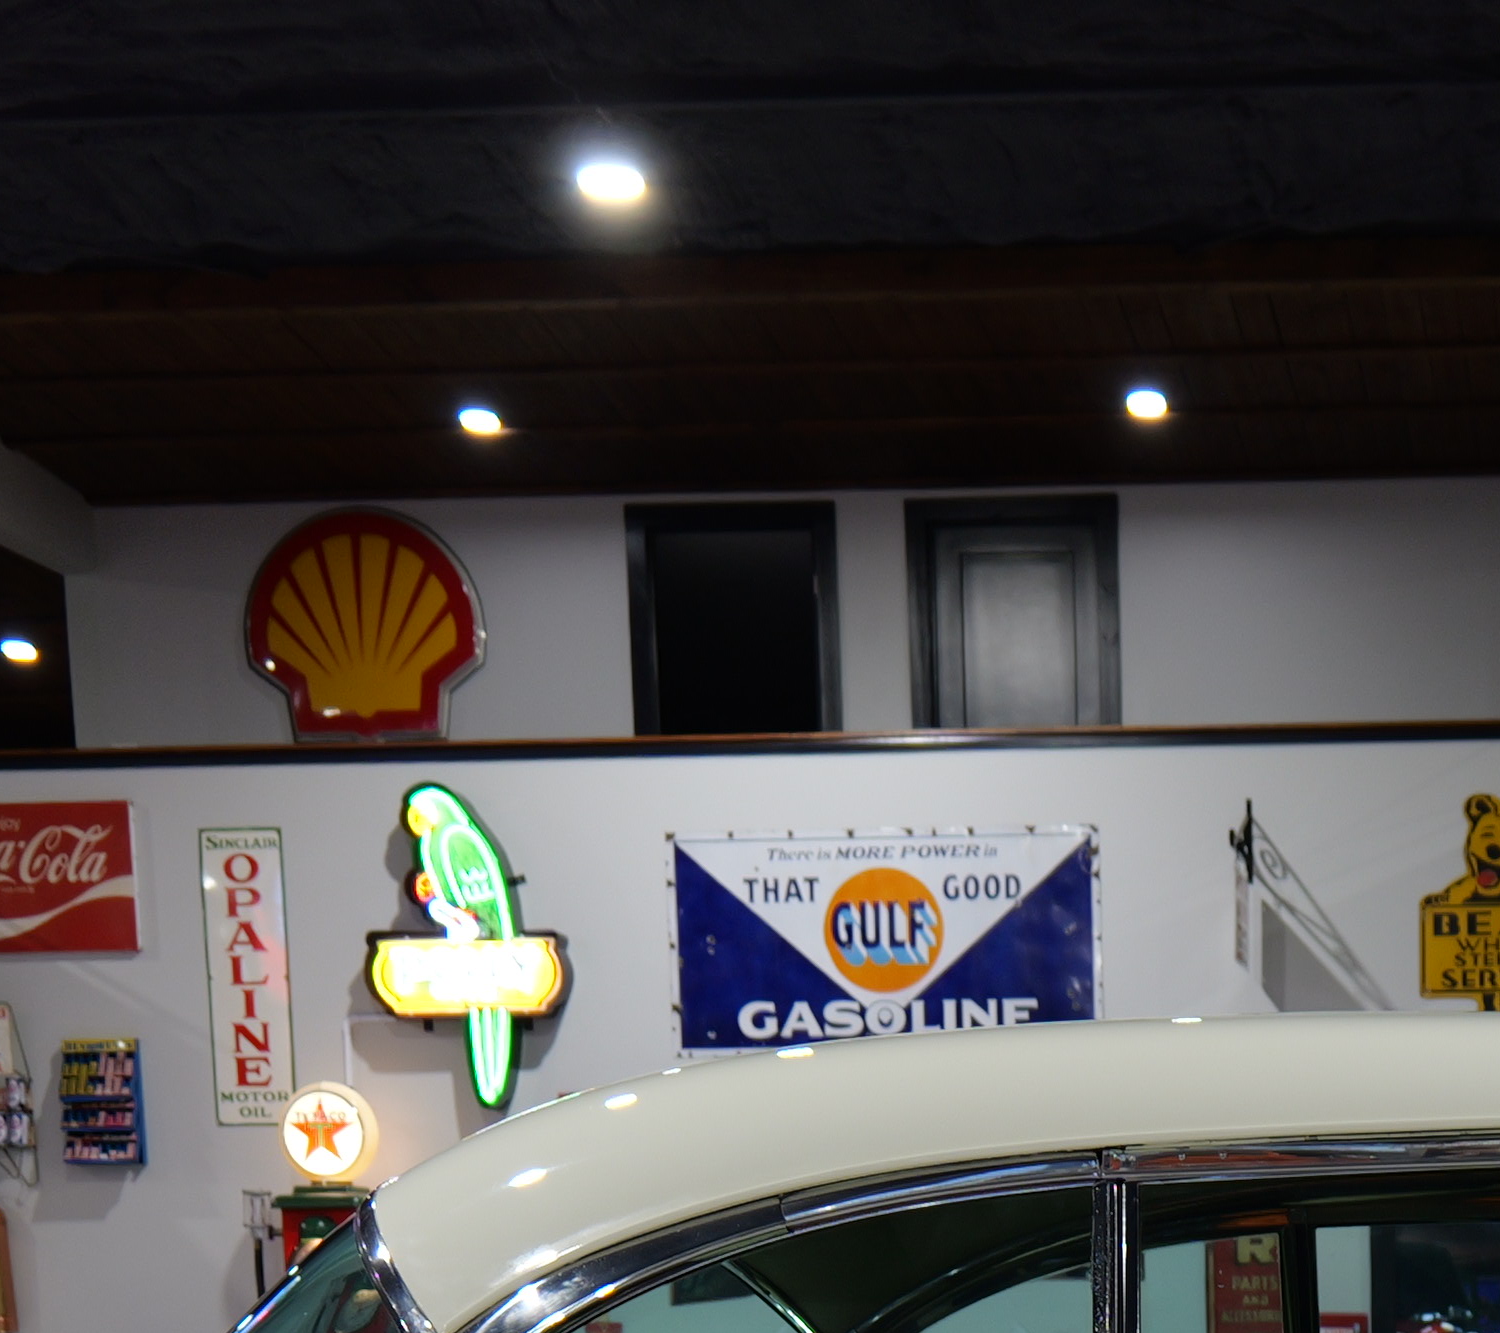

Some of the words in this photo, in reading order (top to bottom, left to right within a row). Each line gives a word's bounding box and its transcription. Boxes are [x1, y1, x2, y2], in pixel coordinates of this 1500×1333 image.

[766, 847, 814, 861] There
[816, 847, 833, 861] is
[834, 846, 895, 861] MORE
[899, 844, 981, 859] POWER
[983, 844, 998, 858] in
[743, 875, 820, 902] THAT
[942, 873, 1022, 900] GOOD
[831, 899, 933, 958] GULF
[223, 853, 273, 1088] OPALINE
[219, 1091, 291, 1103] MOTOR
[239, 1106, 272, 1118] OIL
[1231, 1275, 1279, 1290] PARTS
